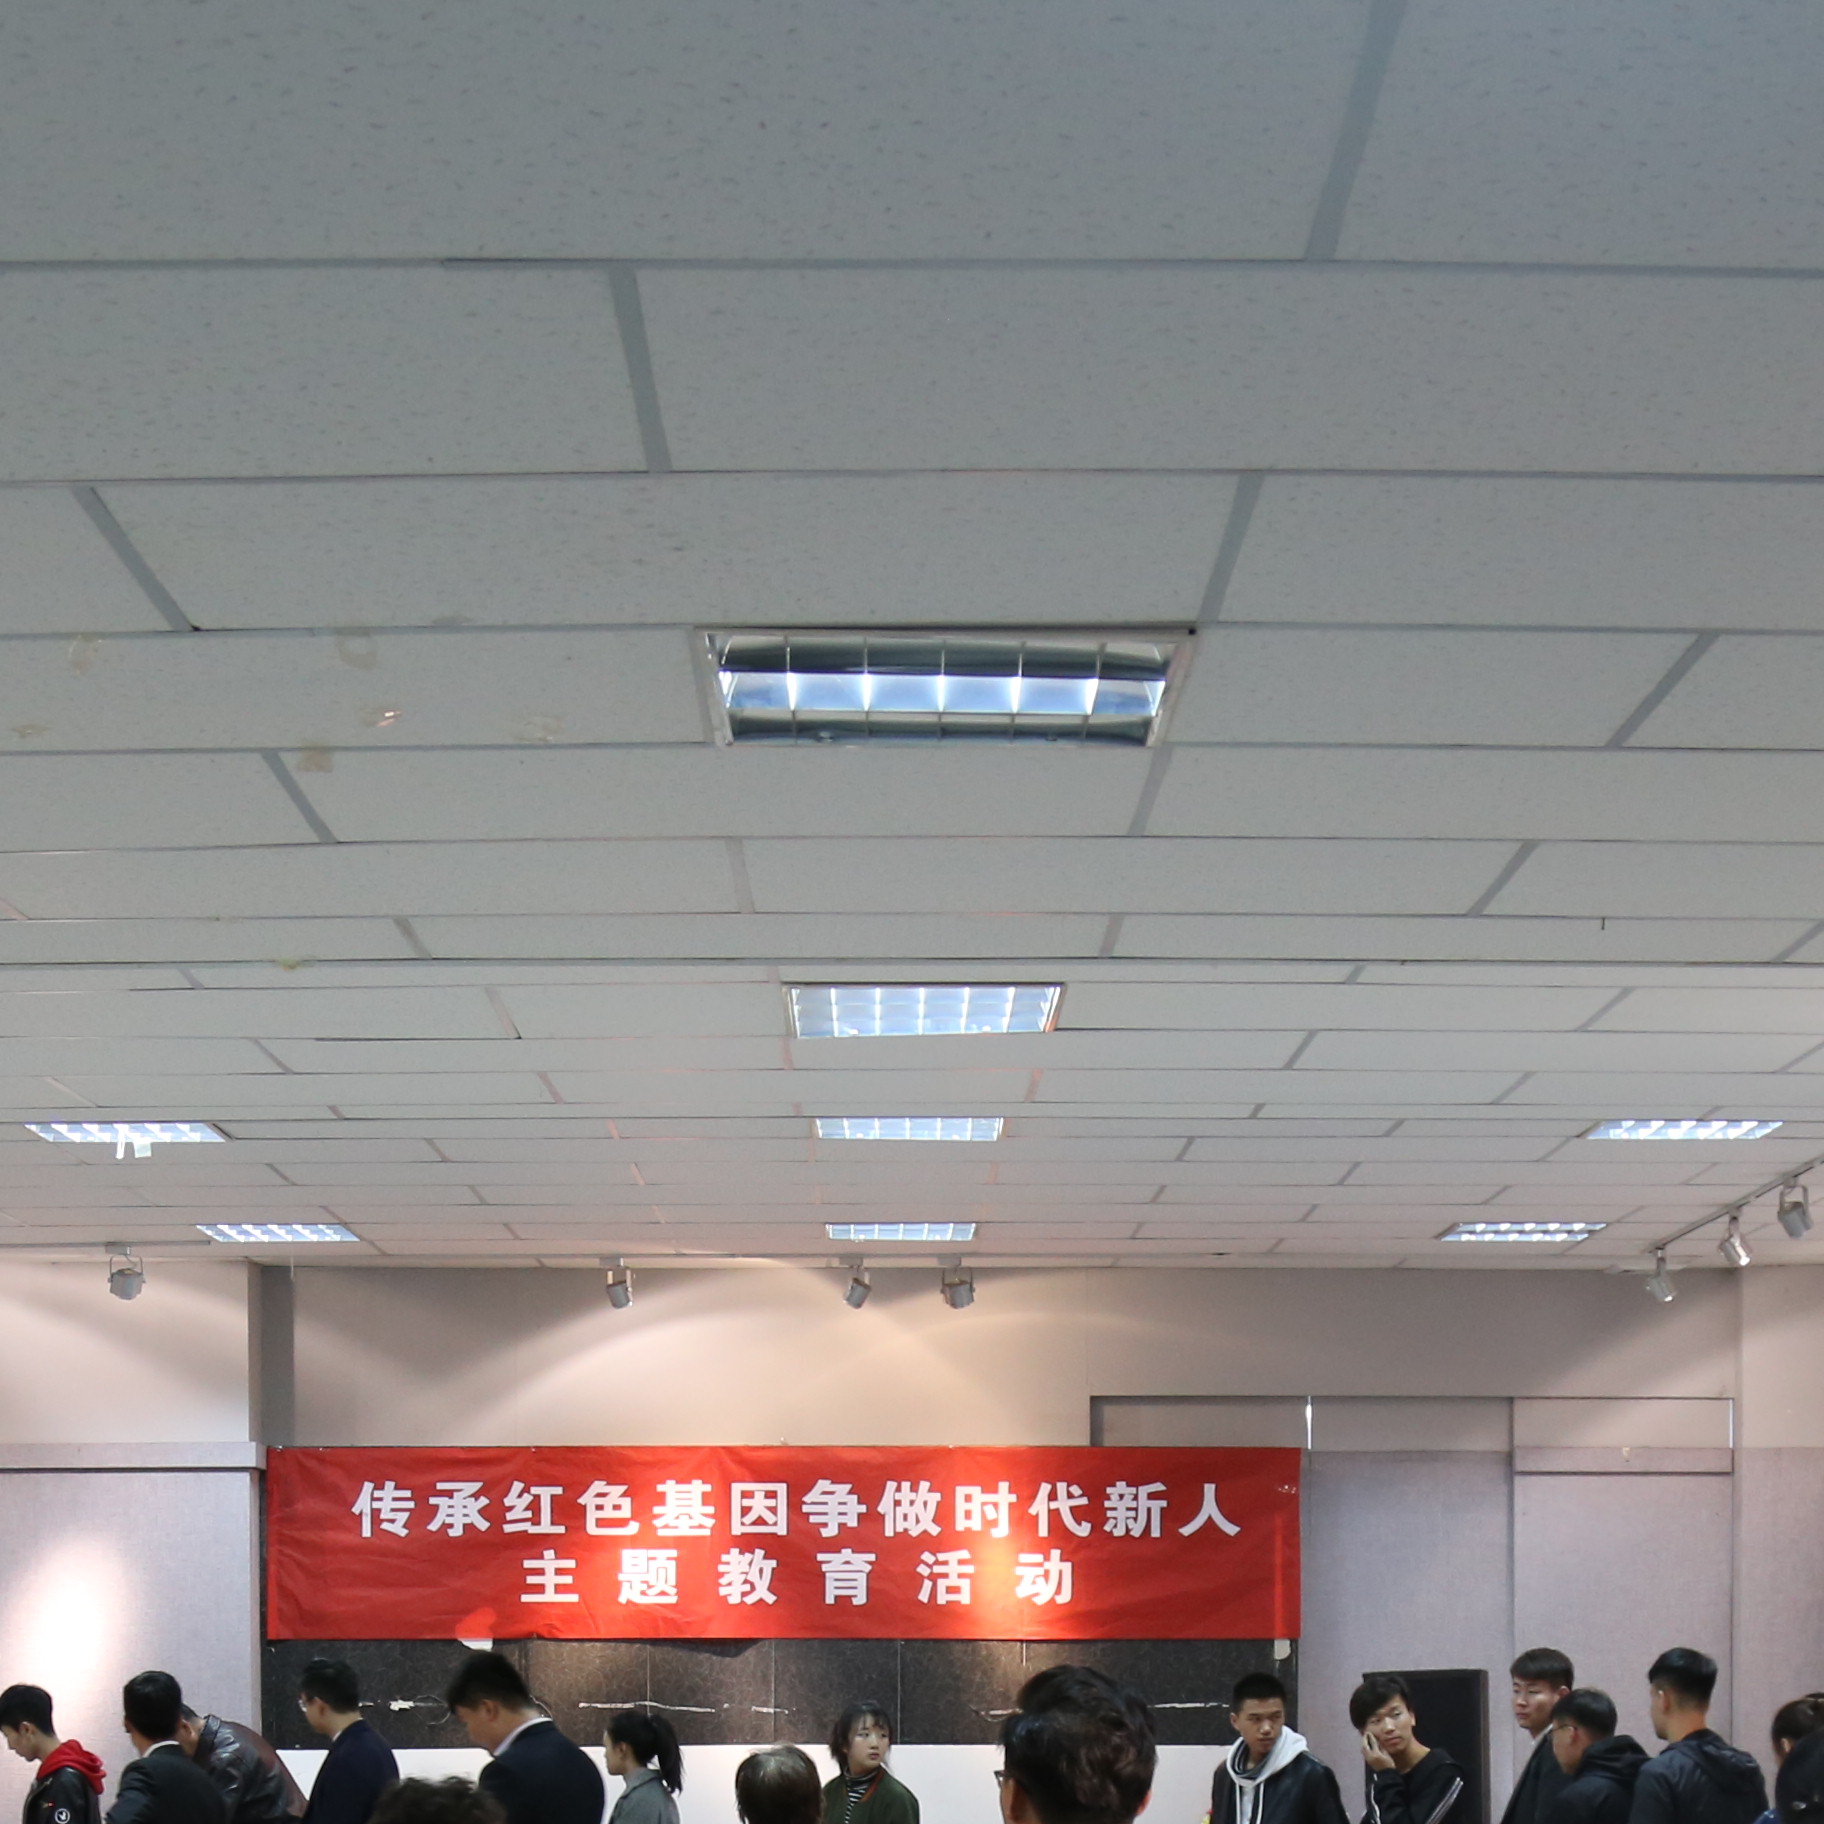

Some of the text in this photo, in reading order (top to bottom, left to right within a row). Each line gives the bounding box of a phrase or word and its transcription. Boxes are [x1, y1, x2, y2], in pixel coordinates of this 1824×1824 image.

[352, 1479, 1241, 1538] 传承红色基因争做时代新人
[520, 1548, 1075, 1607] 主题教育活动
